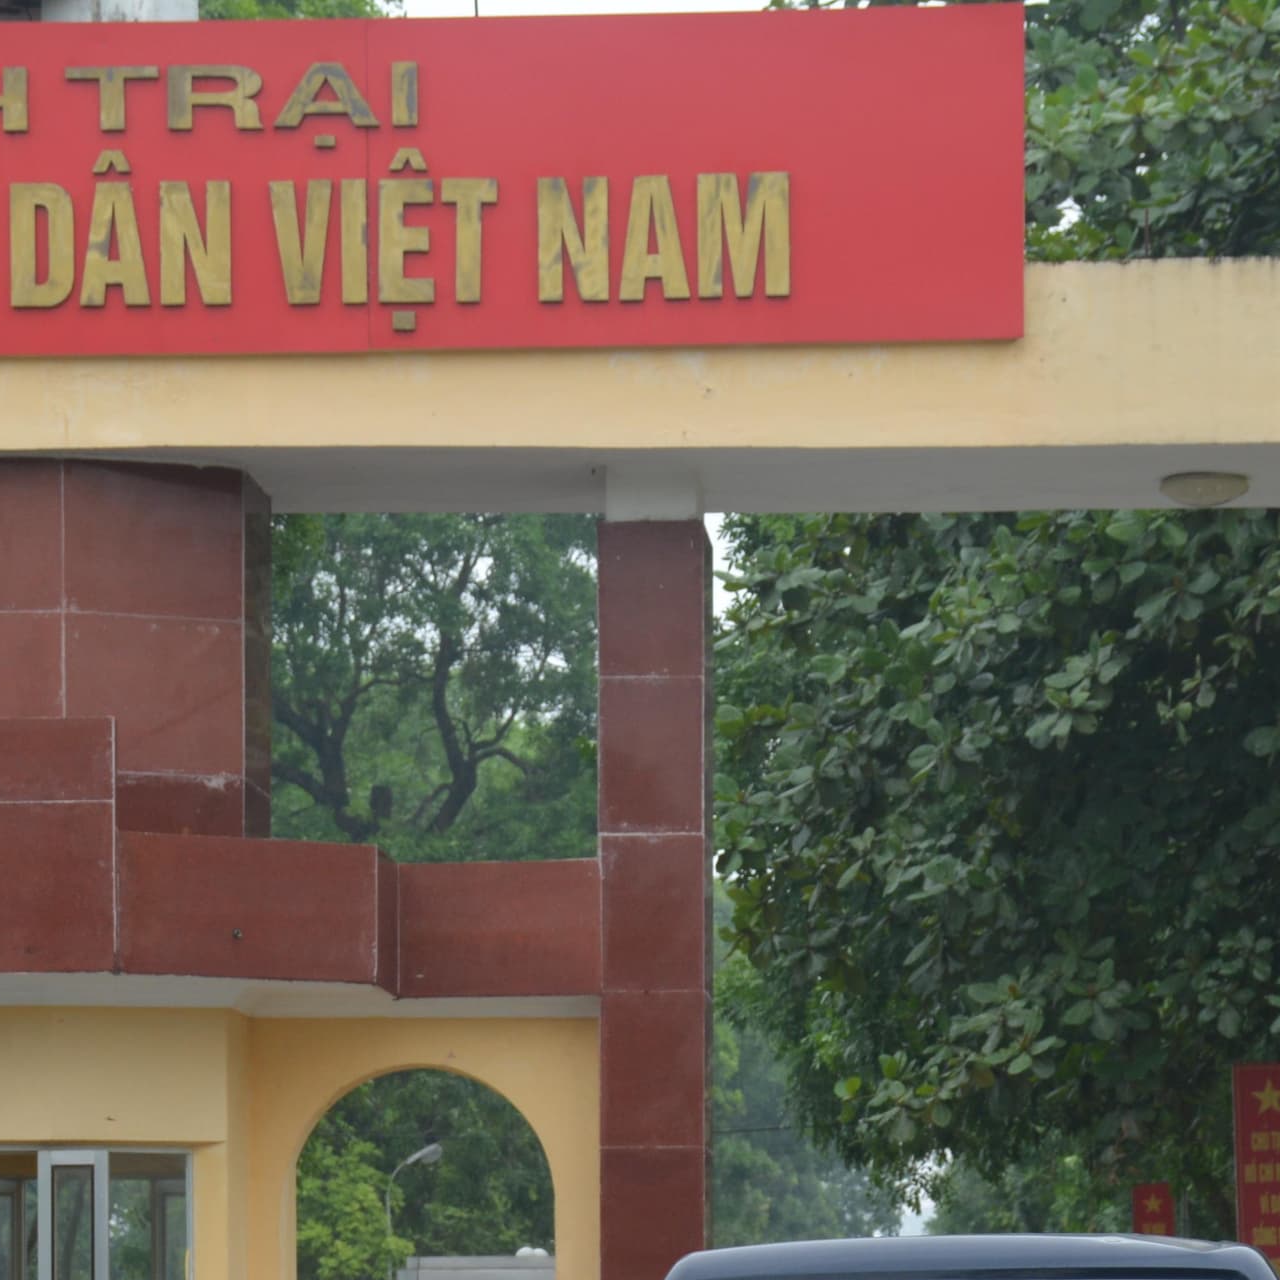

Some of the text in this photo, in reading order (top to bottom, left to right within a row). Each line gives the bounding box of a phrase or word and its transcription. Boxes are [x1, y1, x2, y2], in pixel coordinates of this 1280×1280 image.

[64, 61, 419, 148] TRẠI
[9, 149, 232, 308] DÂN
[268, 147, 498, 332] VIỆT
[537, 171, 791, 303] NAM
